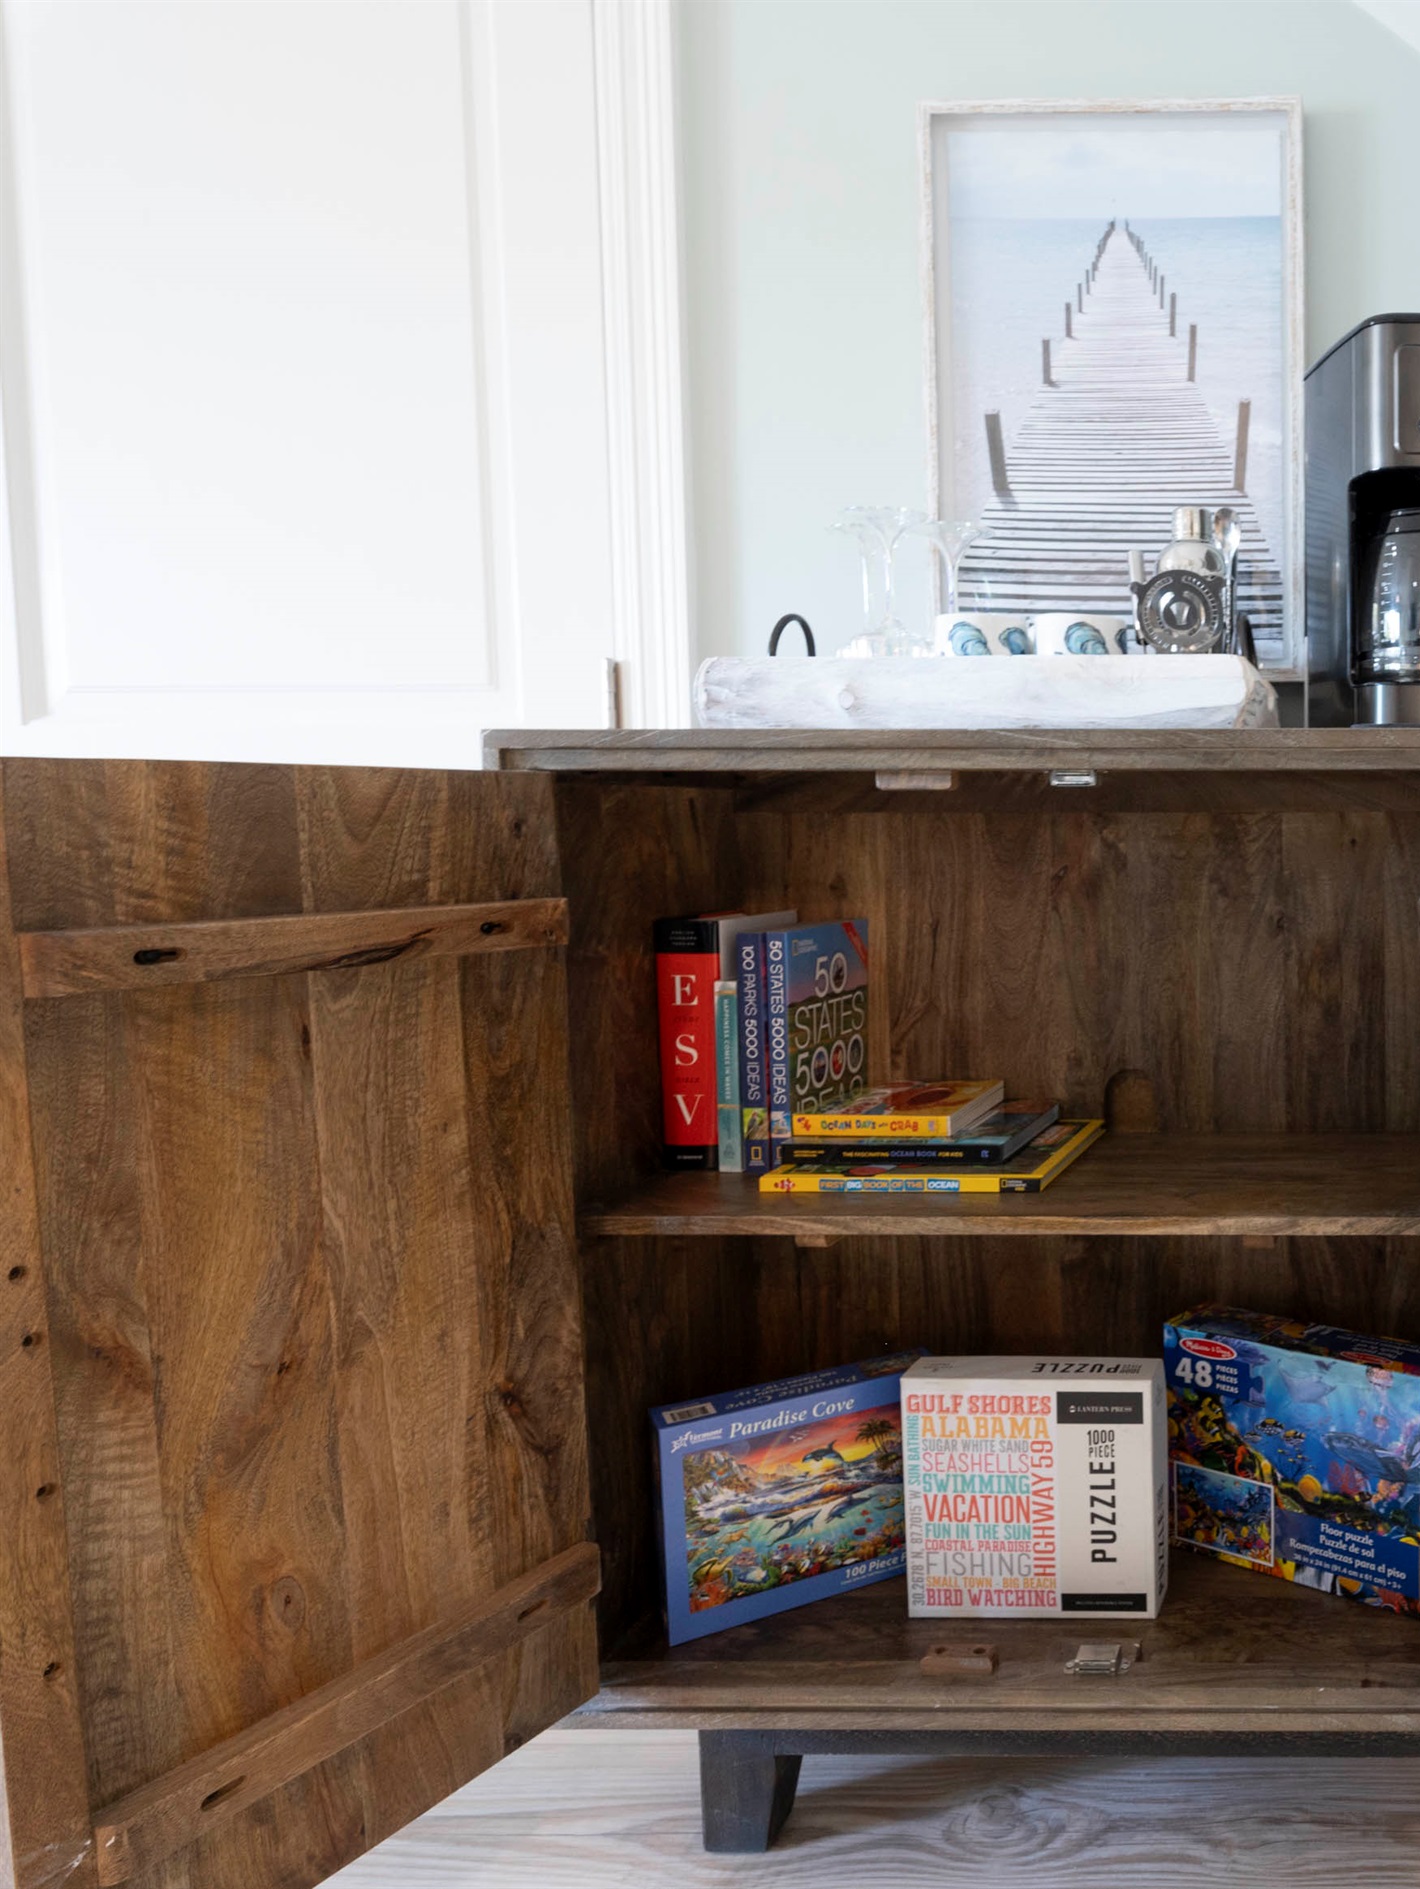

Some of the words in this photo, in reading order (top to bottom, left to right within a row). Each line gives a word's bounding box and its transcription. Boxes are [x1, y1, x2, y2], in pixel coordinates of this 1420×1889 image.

[742, 945, 755, 970] 100
[769, 941, 783, 961] 50
[814, 952, 847, 998] 50
[744, 974, 757, 1016] PARKS
[770, 964, 784, 1014] STATES
[794, 991, 865, 1049] STATES
[745, 1018, 758, 1059] 5000
[771, 1017, 785, 1060] 5000
[795, 1033, 864, 1096] 5000
[747, 1062, 760, 1101] IDEAS
[772, 1063, 787, 1104] IDEAS
[821, 1119, 852, 1131] OCEAN
[855, 1119, 876, 1130] DAYS
[890, 1119, 919, 1132] CRAB
[890, 1150, 915, 1158] OCEAN
[916, 1150, 937, 1158] BOOK
[820, 1180, 845, 1190] FIRST
[846, 1180, 862, 1190] BIG
[863, 1180, 889, 1190] BOOK
[890, 1180, 904, 1190] OF
[905, 1180, 924, 1190] THE
[927, 1180, 959, 1189] OCEAN
[1032, 1363, 1121, 1374] PUZZLE
[1175, 1357, 1213, 1388] 48
[1216, 1365, 1238, 1375] PIECES
[1216, 1384, 1239, 1394] PIEZAS
[906, 1394, 964, 1414] GULF
[967, 1395, 1052, 1415] SHORES
[729, 1408, 809, 1439] Paradise
[812, 1398, 855, 1418] Cove
[921, 1416, 1050, 1439] ALABAMA
[907, 1415, 920, 1461] BATHING
[922, 1439, 958, 1452] SUGAR
[961, 1440, 996, 1452] WHITE
[1000, 1440, 1029, 1453] SAND
[1087, 1430, 1115, 1445] 1000
[1030, 1440, 1054, 1469] 59
[1088, 1444, 1115, 1458] PIECE
[922, 1452, 1030, 1474] SEASHELLS
[908, 1464, 920, 1486] SUN
[922, 1473, 1031, 1494] SWIMMING
[909, 1490, 921, 1500] W
[923, 1494, 1031, 1523] VACATION
[1089, 1462, 1117, 1562] PUZZLE
[925, 1523, 950, 1539] FUN
[956, 1523, 970, 1540] IN
[974, 1524, 1000, 1540] THE
[1004, 1524, 1032, 1540] SUN
[1031, 1473, 1056, 1577] HIGHWAY
[1320, 1523, 1343, 1536] Floor
[1345, 1530, 1374, 1546] puzzle
[924, 1539, 975, 1551] COASTAL
[978, 1540, 1032, 1553] PARADISE
[1319, 1535, 1344, 1550] Puzzle
[1348, 1543, 1360, 1554] de
[1361, 1546, 1375, 1558] sol
[845, 1564, 866, 1579] 100
[868, 1557, 899, 1572] Piece
[926, 1552, 1032, 1577] FISHING
[1289, 1538, 1353, 1565] Rompecabezas
[1354, 1558, 1376, 1572] para
[1377, 1563, 1386, 1573] el
[1387, 1567, 1407, 1580] piso
[926, 1577, 960, 1588] SMALL
[962, 1577, 992, 1588] TOWN
[1002, 1577, 1020, 1589] BIG
[1023, 1577, 1057, 1589] BEACH
[926, 1588, 964, 1607] BIRD
[967, 1588, 1057, 1607] WATCHING
